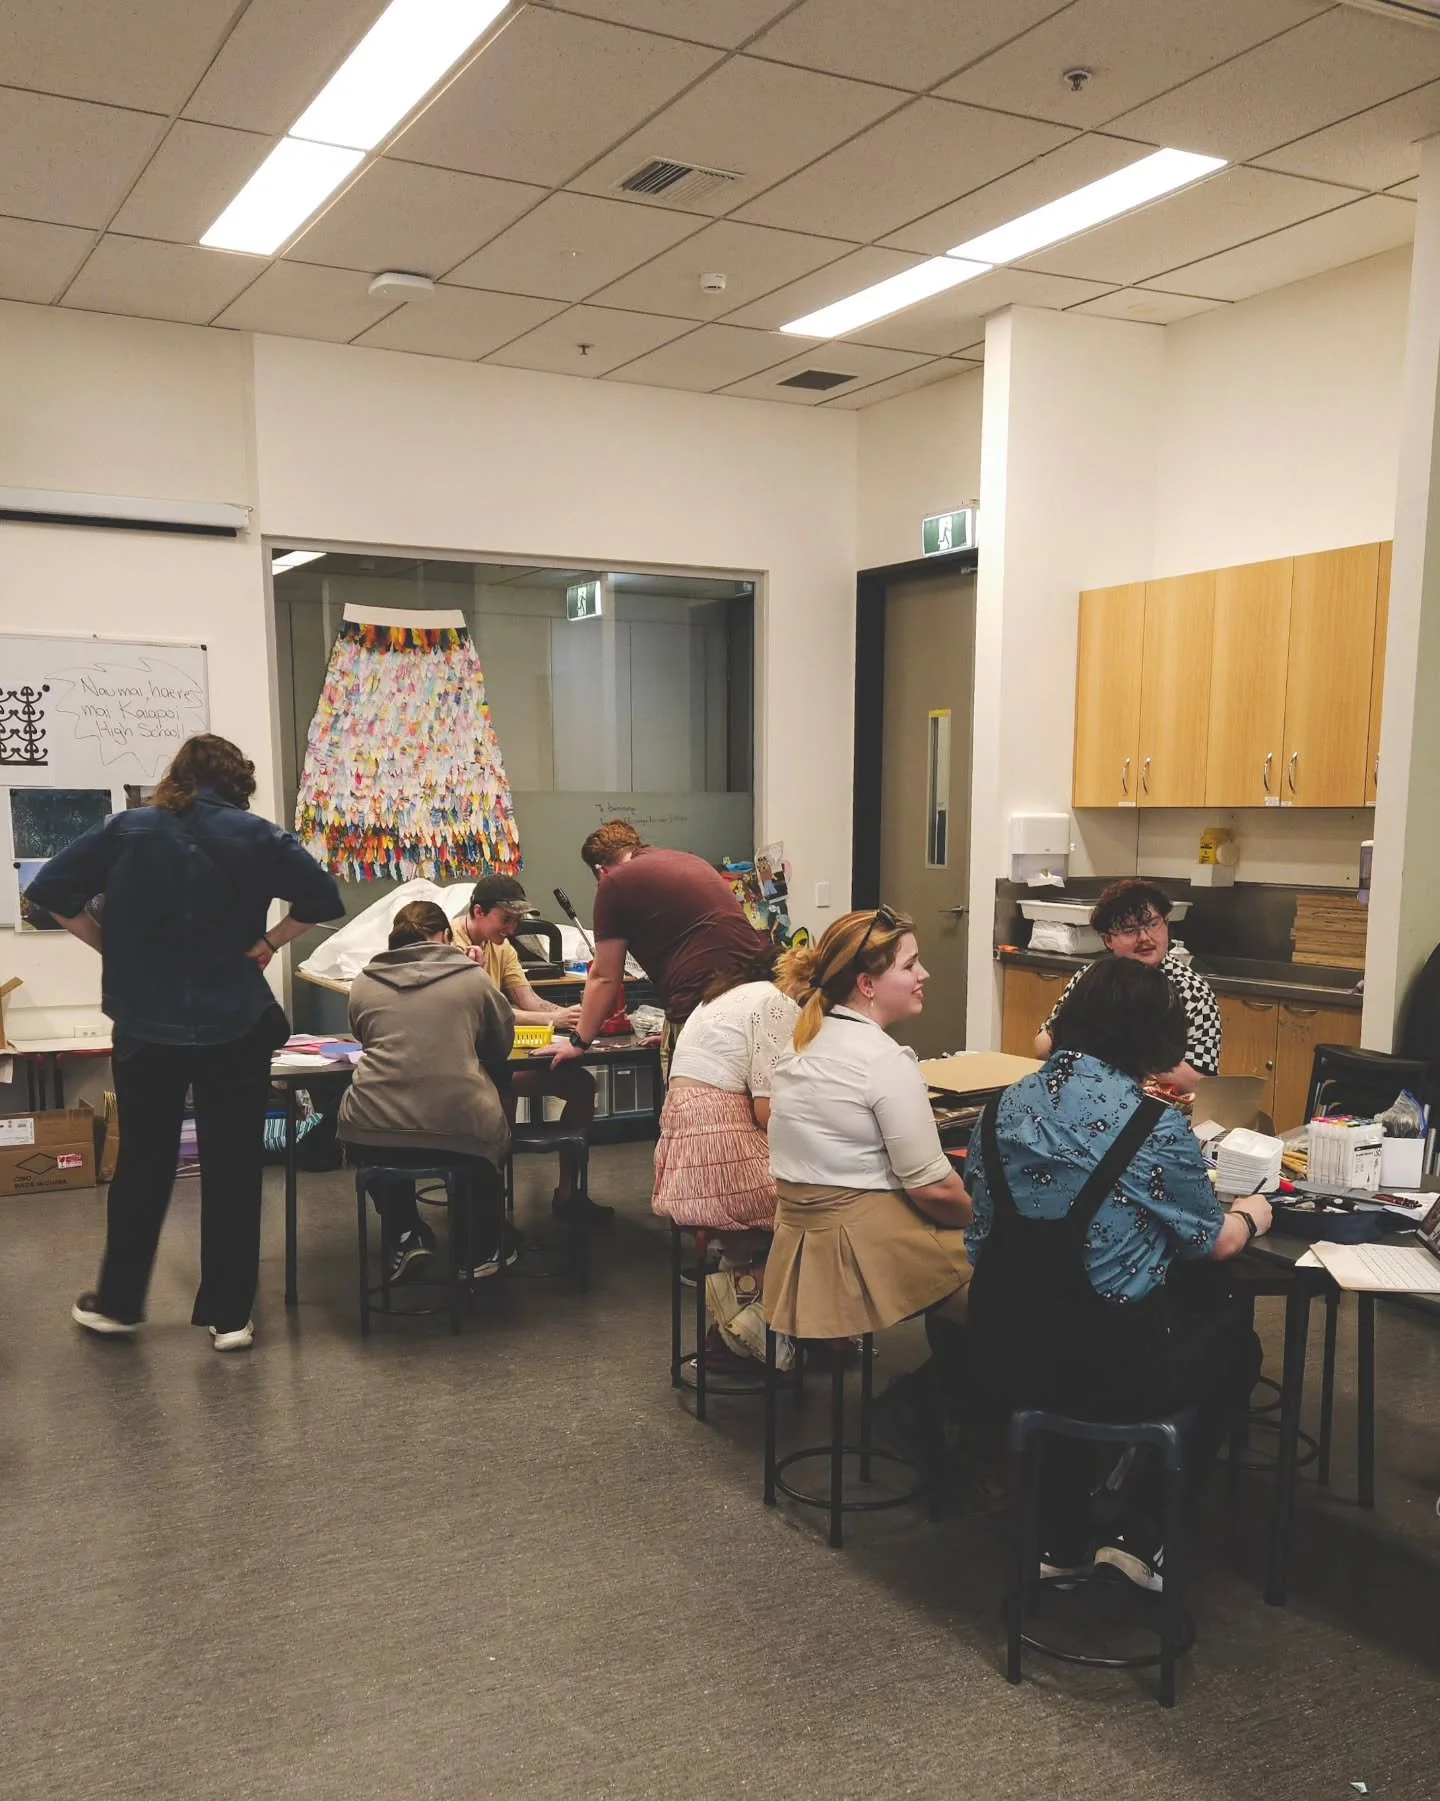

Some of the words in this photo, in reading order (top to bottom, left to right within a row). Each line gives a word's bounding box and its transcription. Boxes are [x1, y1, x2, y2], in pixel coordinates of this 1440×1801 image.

[81, 704, 111, 719] mai
[118, 700, 179, 728] Kaiapoi
[95, 720, 134, 745] High
